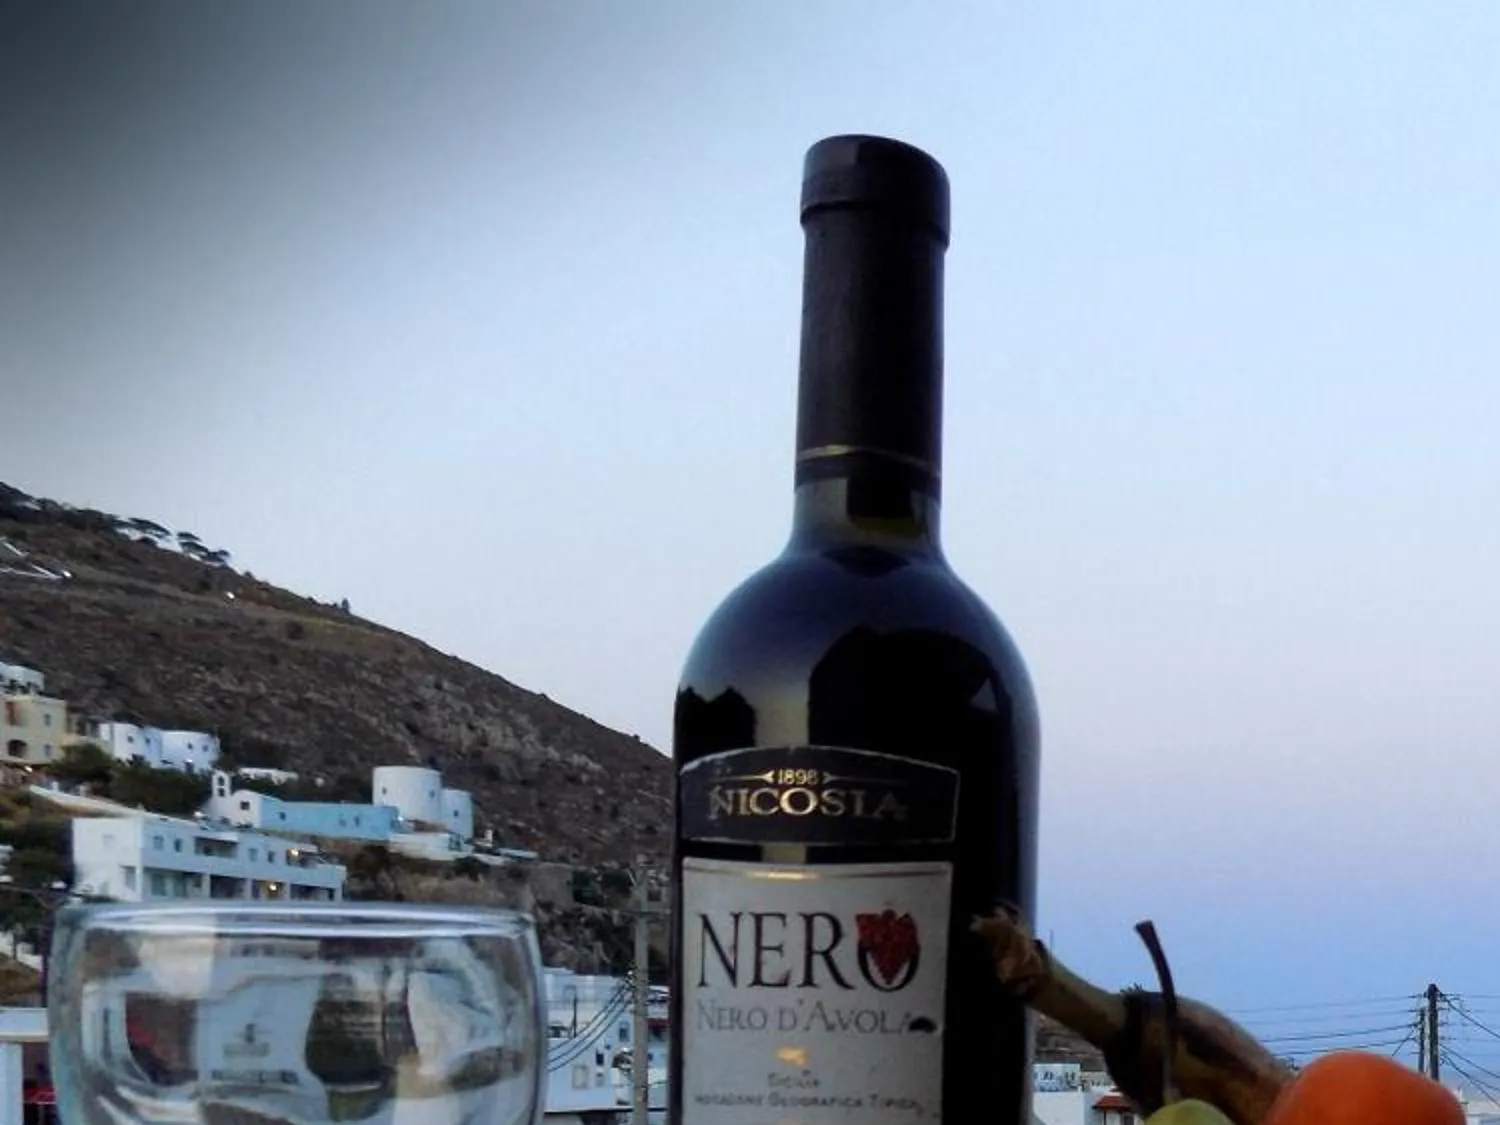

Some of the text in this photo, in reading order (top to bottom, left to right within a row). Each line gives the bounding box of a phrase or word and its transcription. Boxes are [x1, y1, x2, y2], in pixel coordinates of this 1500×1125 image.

[707, 785, 910, 820] NICOSIA
[696, 909, 922, 993] NERO
[776, 999, 938, 1034] D'AVOL
